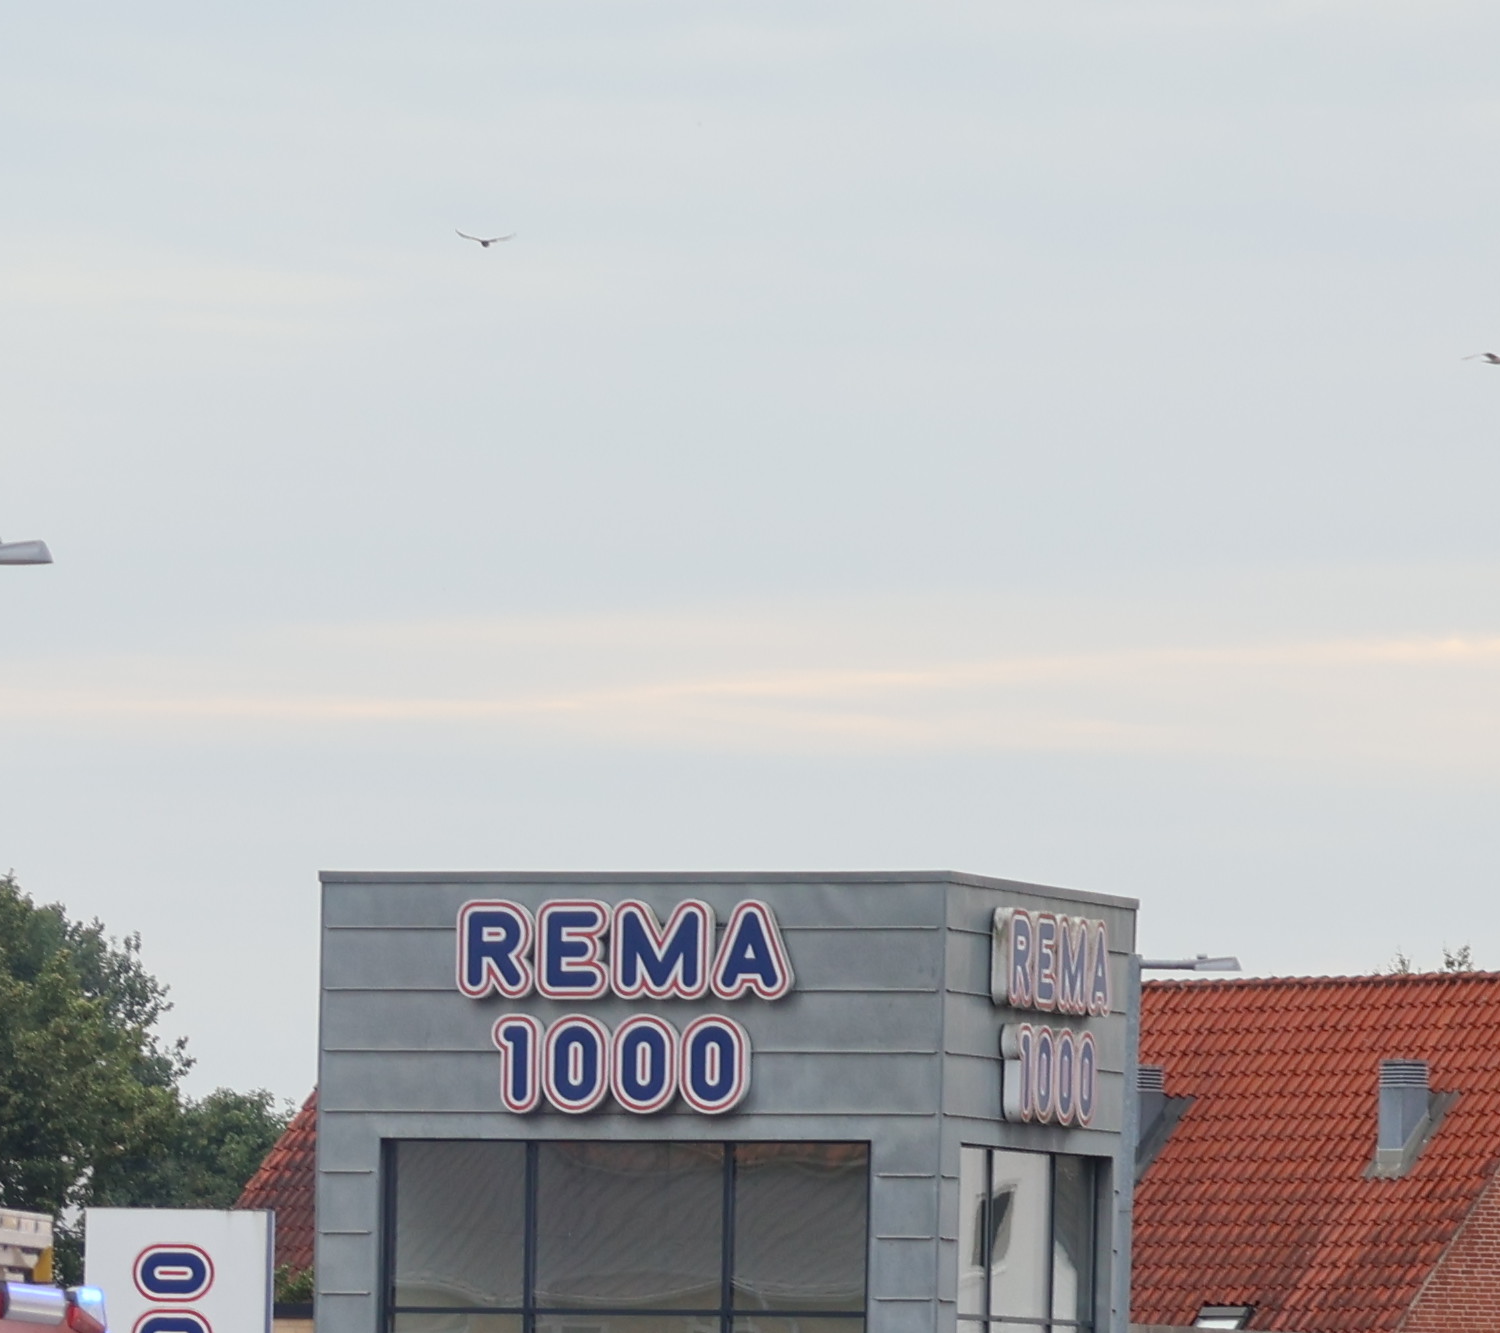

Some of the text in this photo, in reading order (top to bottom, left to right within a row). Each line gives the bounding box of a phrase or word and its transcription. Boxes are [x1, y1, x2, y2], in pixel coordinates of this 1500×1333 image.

[456, 899, 794, 999] REMA
[1008, 908, 1111, 1017] REMA
[491, 1013, 751, 1114] 1000
[1016, 1023, 1098, 1127] 1000
